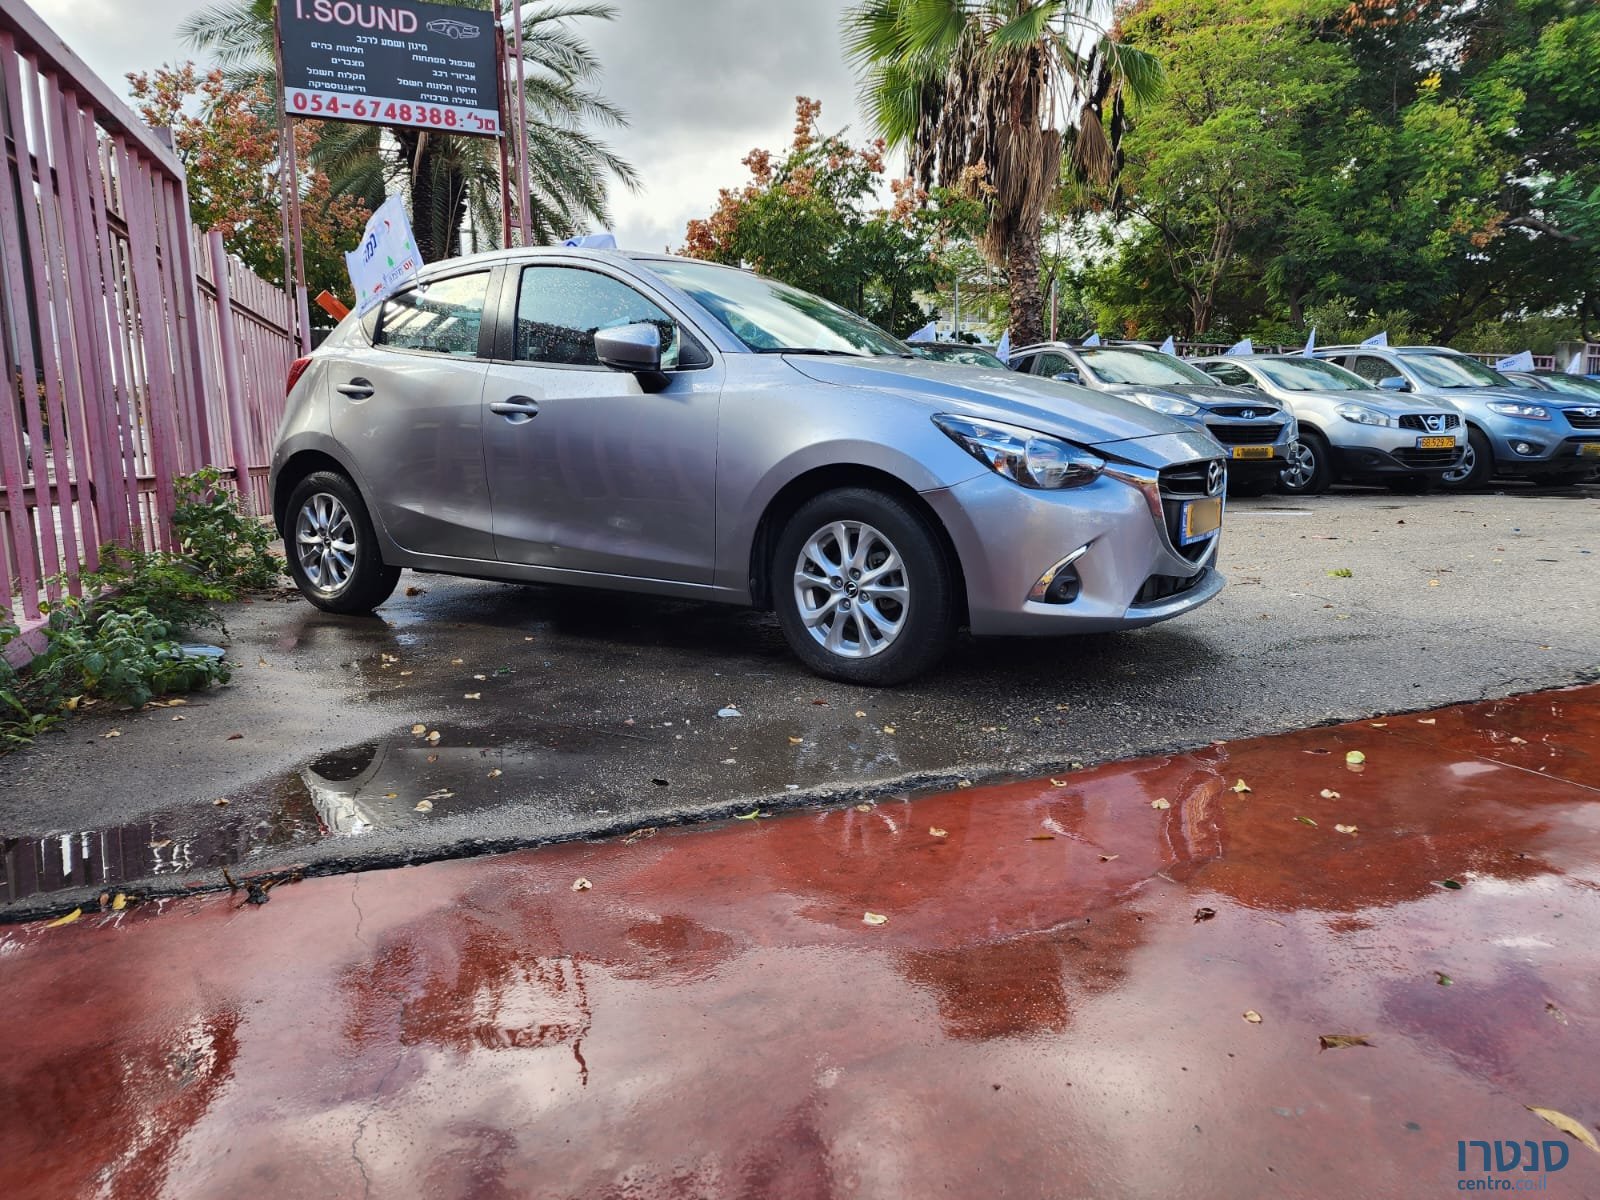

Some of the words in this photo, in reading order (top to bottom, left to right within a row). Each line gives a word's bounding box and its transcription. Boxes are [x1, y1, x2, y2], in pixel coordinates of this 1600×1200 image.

[356, 35, 378, 44] לרכב
[381, 38, 405, 49] ושמע
[311, 41, 332, 50] כהים
[336, 44, 364, 54] חלונות
[408, 42, 428, 51] מיגון
[331, 57, 365, 67] מצברים
[412, 54, 446, 64] מפתחות
[448, 58, 476, 68] שכפול
[306, 66, 334, 77] חשמל
[337, 71, 366, 81] תקלות
[432, 70, 448, 78] רכב
[450, 72, 476, 81] אביזרי
[396, 77, 423, 88] חשמל
[426, 81, 453, 91] חלונות
[455, 85, 477, 94] תיקון
[420, 92, 449, 102] מרכזית
[452, 96, 478, 106] ונעילה
[292, 92, 457, 127] 054-6748388
